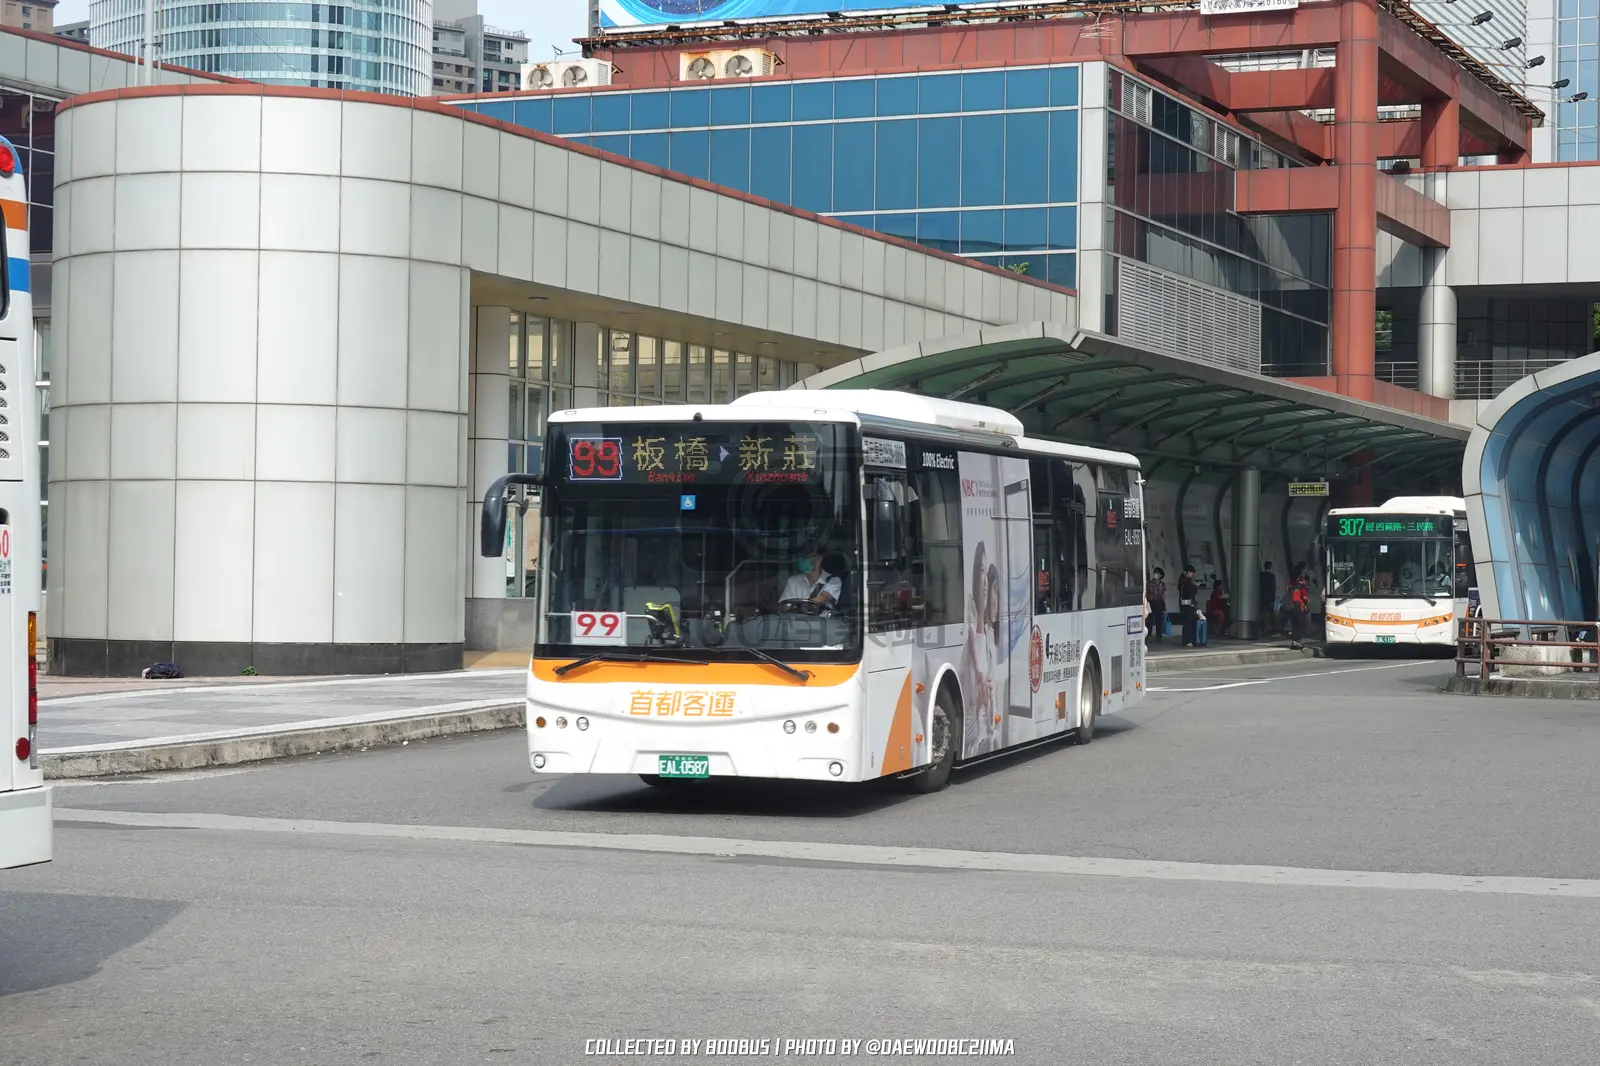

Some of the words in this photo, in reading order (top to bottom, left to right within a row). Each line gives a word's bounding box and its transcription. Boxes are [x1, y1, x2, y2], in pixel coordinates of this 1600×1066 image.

[573, 441, 619, 476] 99
[632, 435, 709, 471] 板橋
[738, 435, 817, 471] 新莊
[922, 451, 936, 467] 100%
[936, 453, 955, 470] Electric
[1339, 518, 1365, 536] 307
[0, 529, 9, 558] 0
[577, 613, 619, 636] 99
[629, 689, 737, 717] 首都客運
[659, 760, 708, 775] EAL-0587
